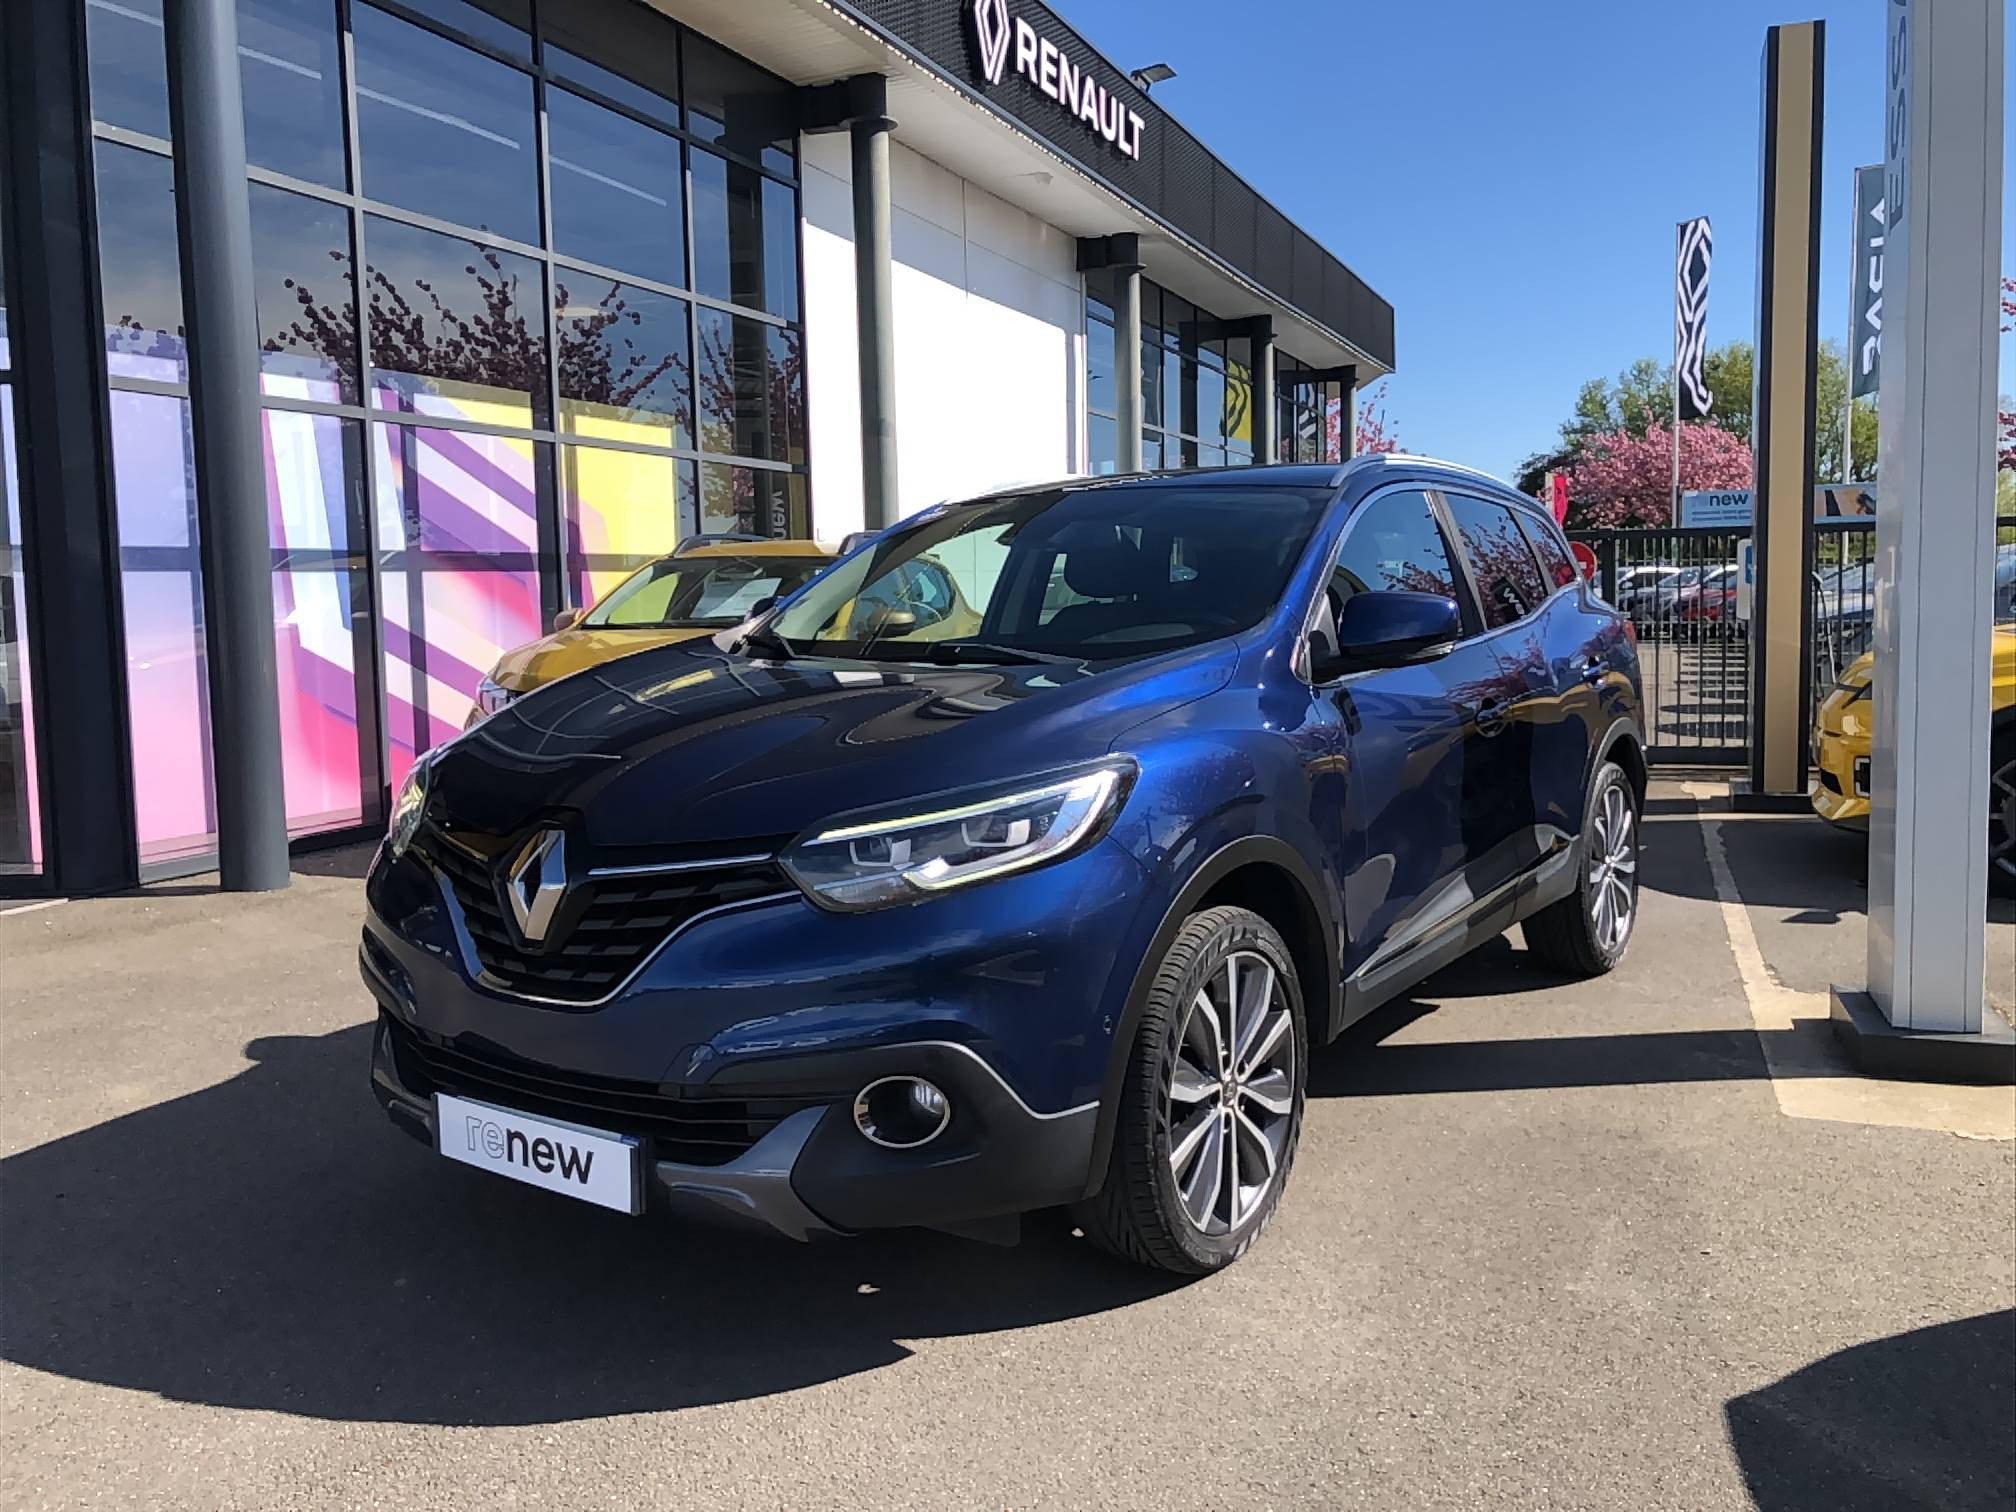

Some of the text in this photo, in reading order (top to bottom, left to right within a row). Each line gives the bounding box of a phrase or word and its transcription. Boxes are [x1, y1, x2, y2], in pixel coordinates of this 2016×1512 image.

[1016, 16, 1145, 161] RENAULT
[1888, 0, 1907, 236] ESS
[465, 1115, 595, 1185] renew
